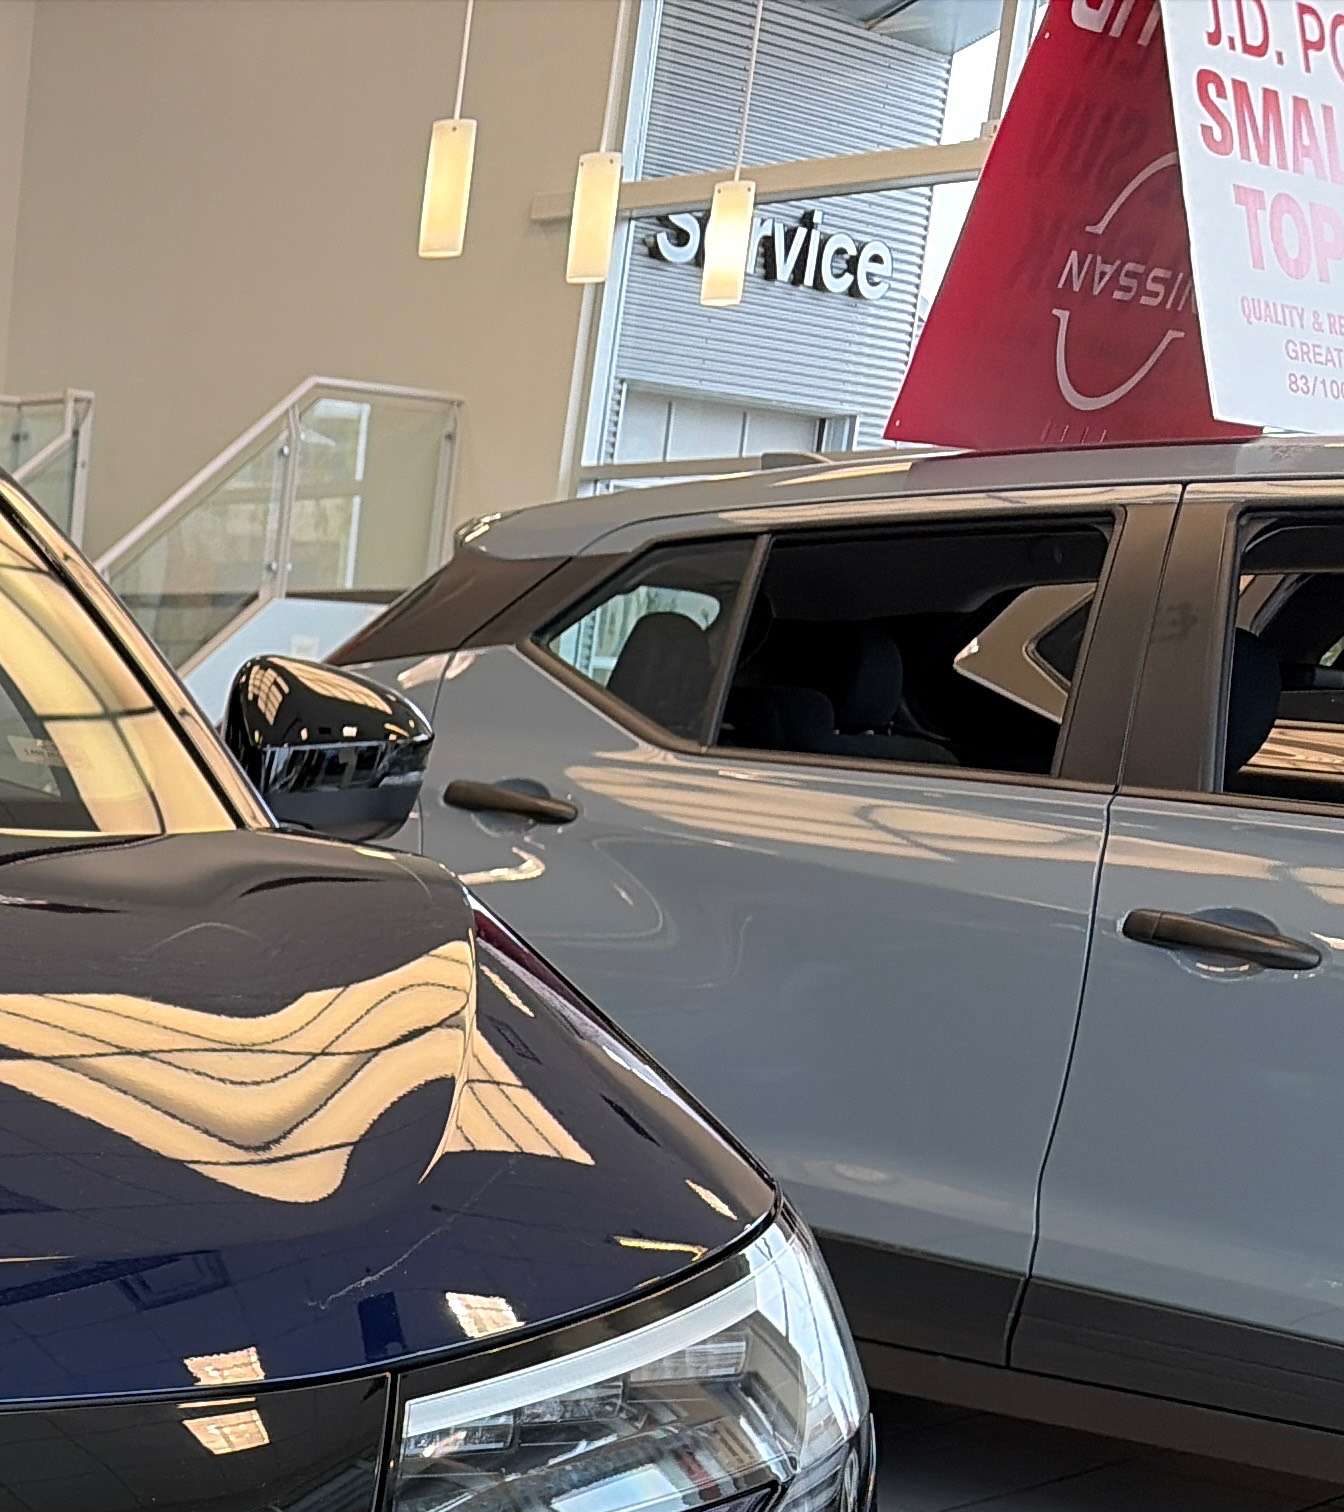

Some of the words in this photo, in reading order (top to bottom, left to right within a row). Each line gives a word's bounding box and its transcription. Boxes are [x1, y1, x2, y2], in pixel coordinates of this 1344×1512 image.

[1206, 0, 1284, 65] J.D.
[656, 208, 894, 300] Srvice
[1233, 183, 1344, 283] TOP
[1240, 296, 1305, 329] QUALITY
[1312, 310, 1324, 333] &
[1285, 339, 1344, 369] GREAT
